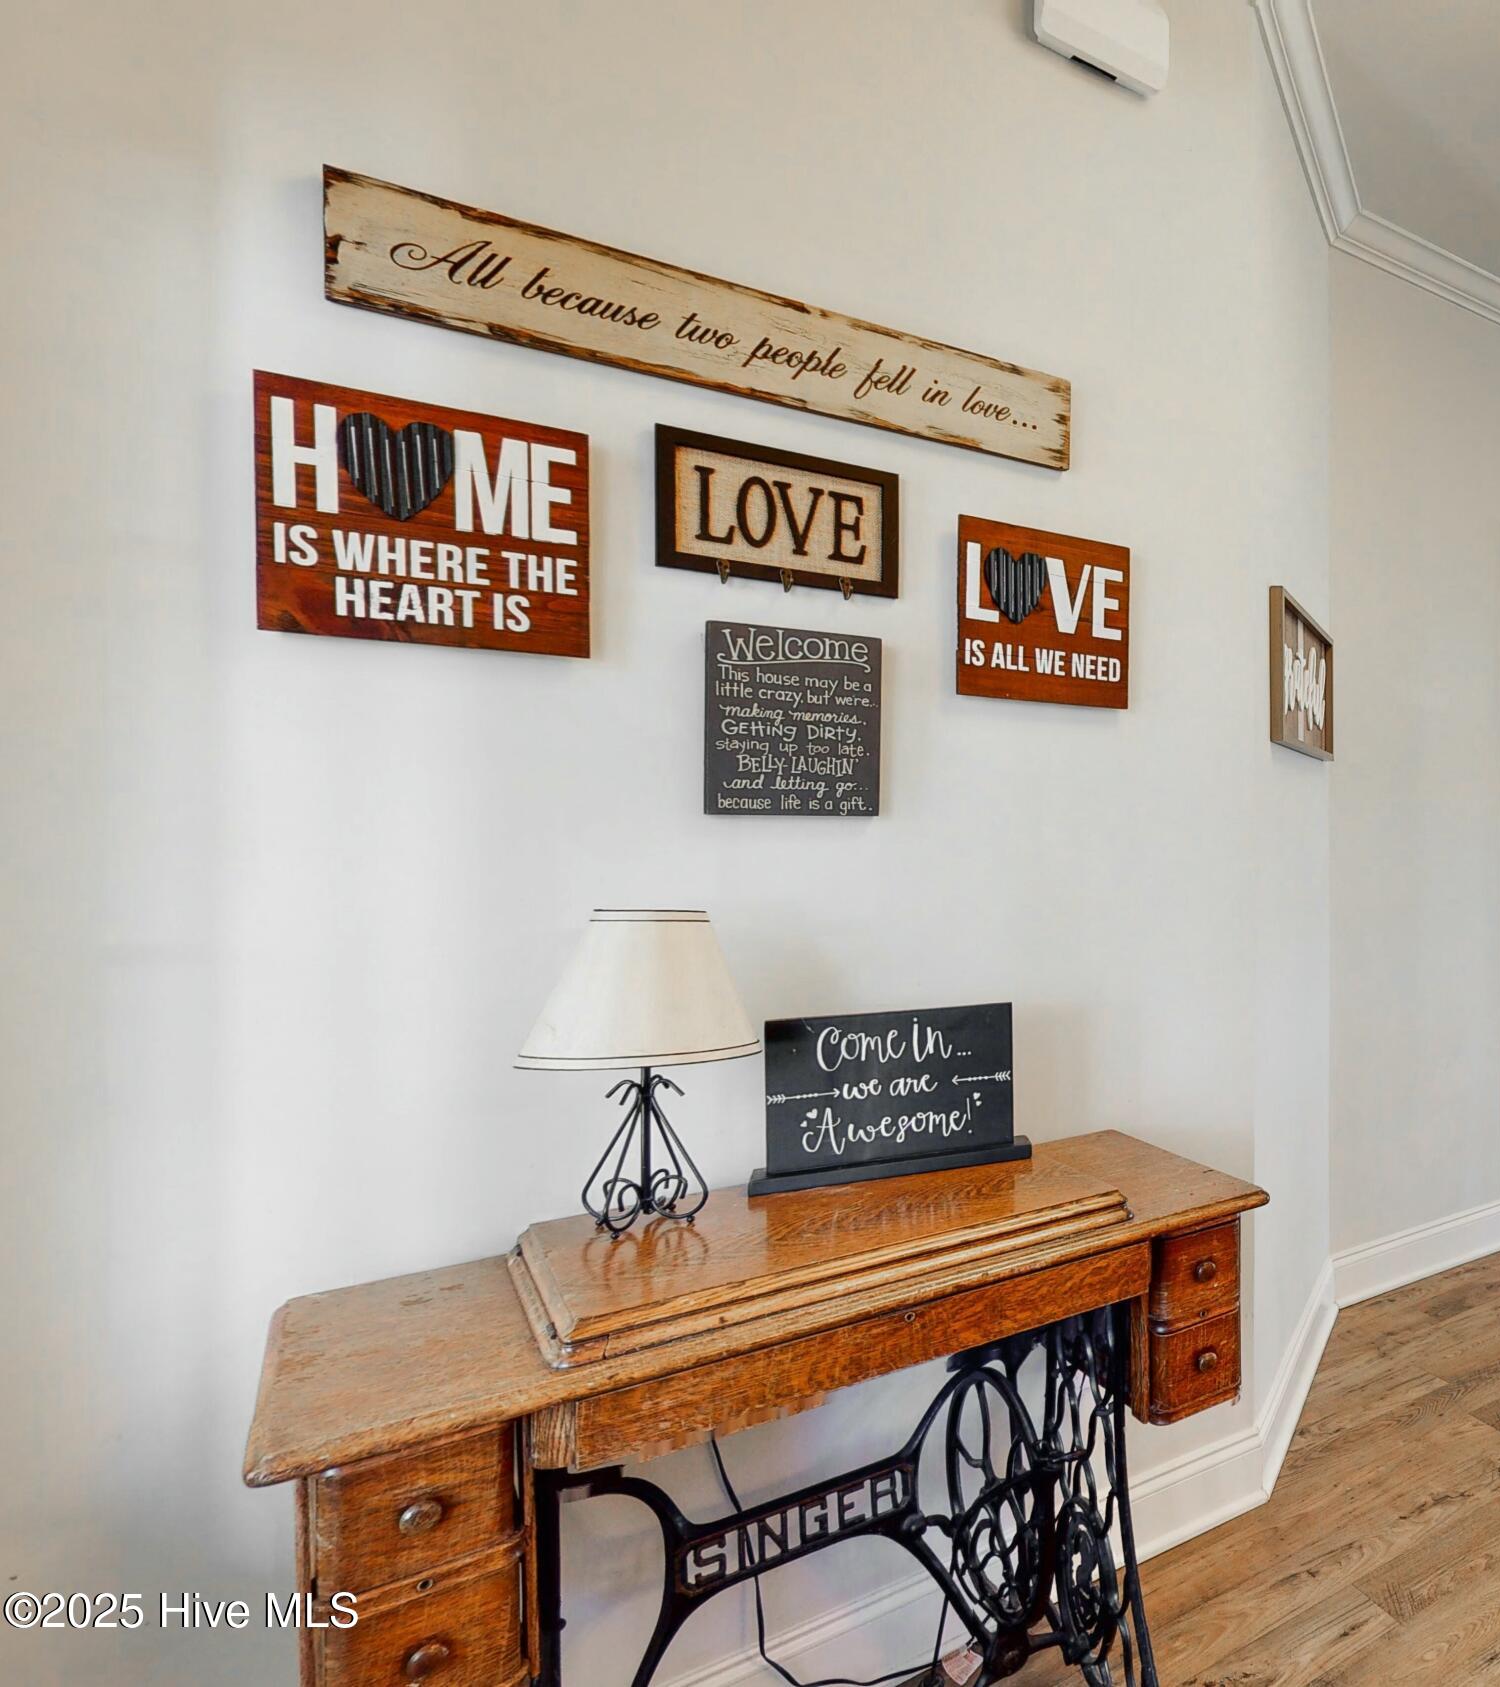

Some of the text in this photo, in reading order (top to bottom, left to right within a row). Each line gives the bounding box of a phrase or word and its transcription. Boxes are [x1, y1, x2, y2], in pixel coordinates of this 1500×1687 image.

[389, 240, 1038, 431] All because two people fell in love...
[270, 395, 578, 546] HME
[693, 464, 867, 565] LOVE
[272, 522, 579, 596] IS WHERE THE
[334, 575, 531, 632] HEART IS
[965, 541, 1124, 641] LVE
[721, 627, 869, 663] Welcome
[964, 638, 1121, 682] IS ALL WE NEED
[715, 680, 753, 699] little
[807, 690, 831, 705] but
[717, 664, 872, 696] This house may be a
[719, 703, 785, 726] making
[715, 738, 870, 758] staying up too late.
[717, 793, 873, 816] because life is a gift.
[723, 774, 765, 790] and
[770, 776, 829, 798] letting
[816, 1025, 907, 1072] Come
[842, 1073, 939, 1101] we are
[801, 1096, 974, 1156] Awesome!
[690, 1470, 904, 1584] SINGER
